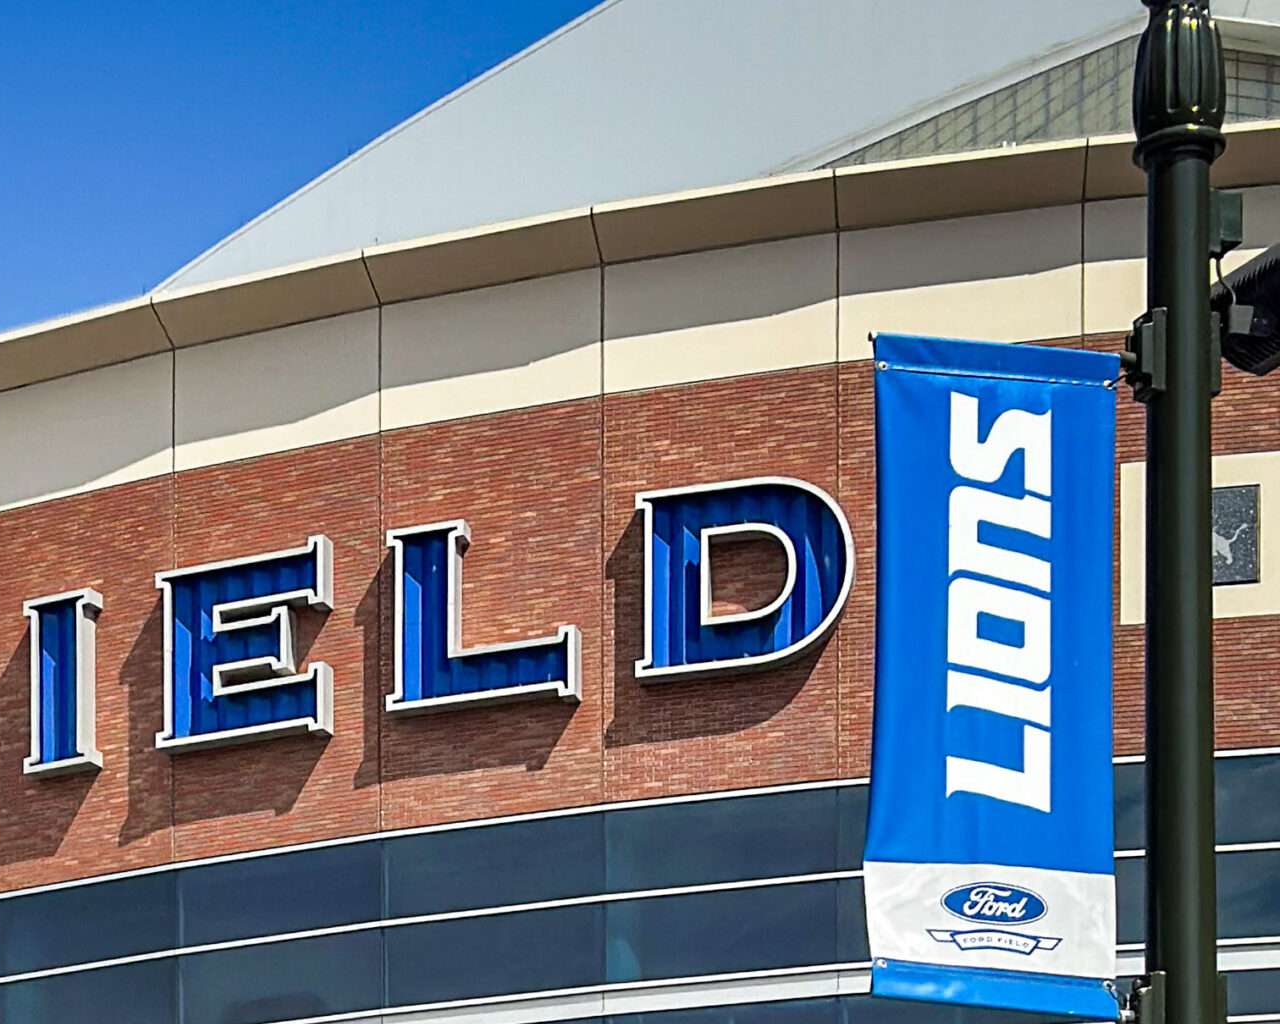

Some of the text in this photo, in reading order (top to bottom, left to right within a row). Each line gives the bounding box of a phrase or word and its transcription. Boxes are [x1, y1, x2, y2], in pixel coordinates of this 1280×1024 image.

[946, 390, 1053, 814] LIONS
[962, 886, 1027, 918] Ford
[963, 935, 1030, 949] FORD FIELD
